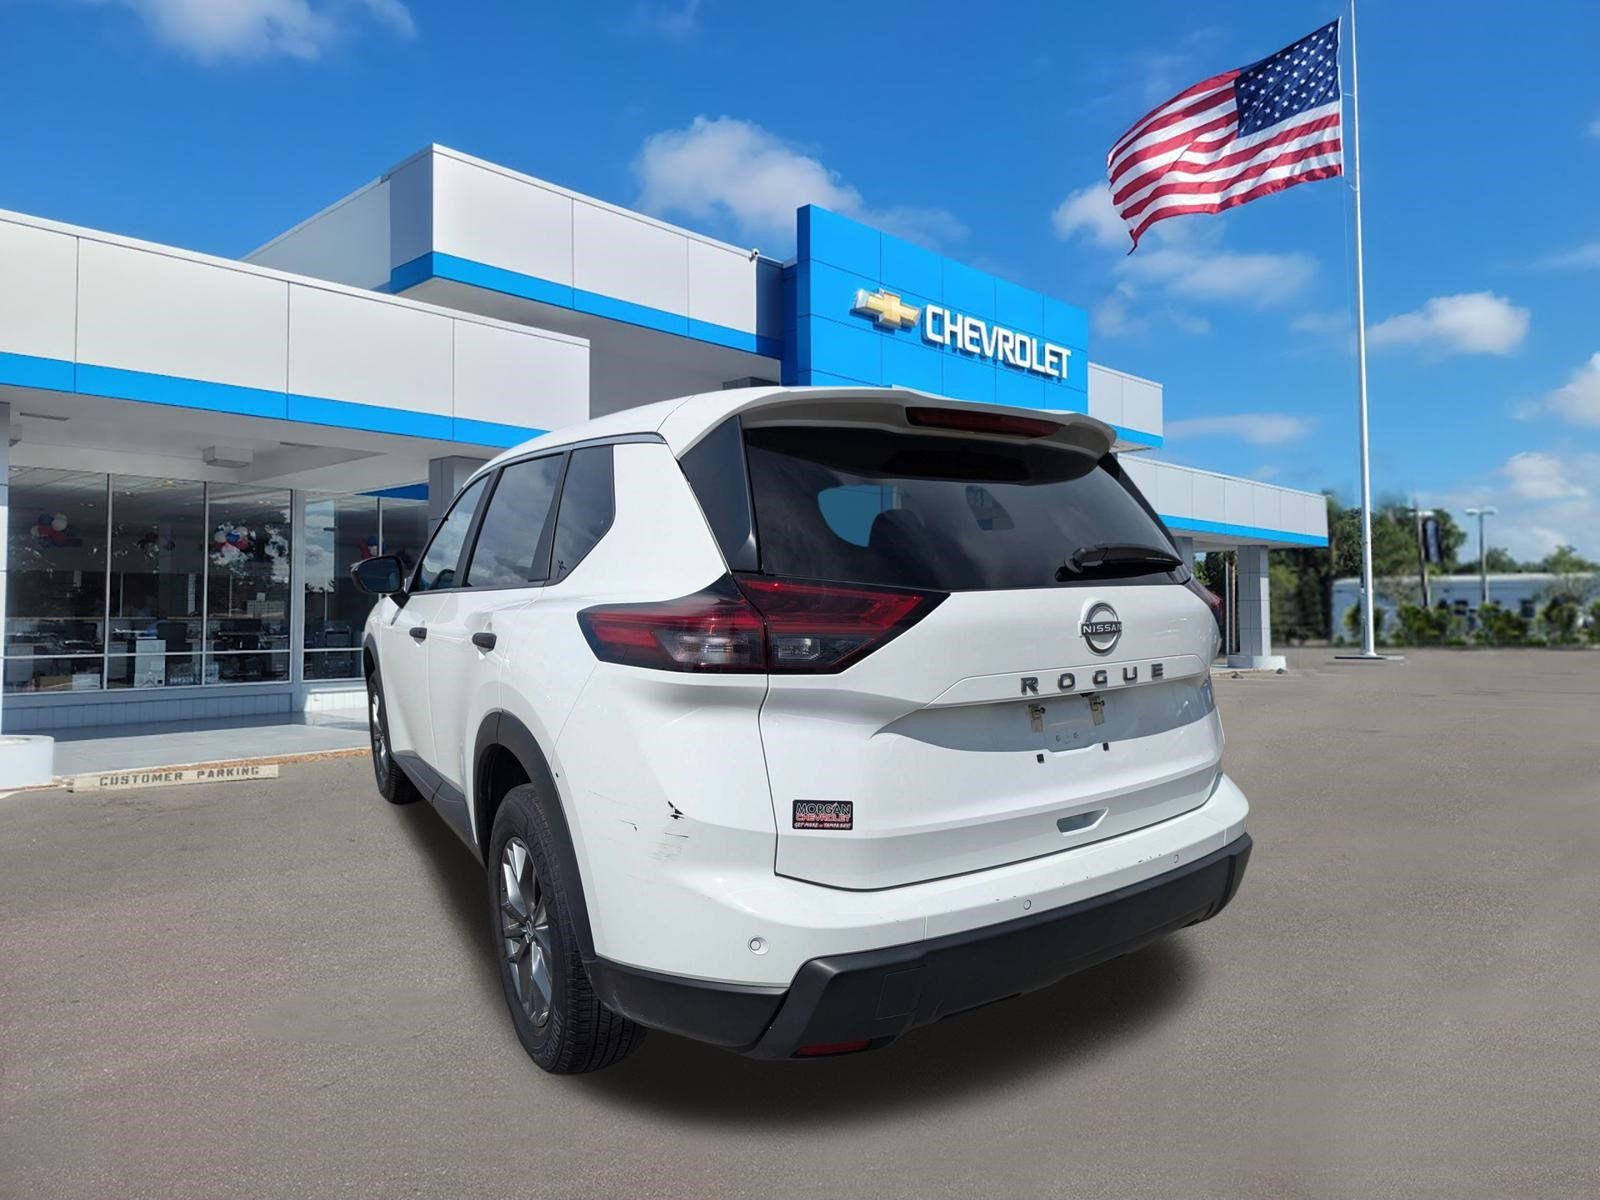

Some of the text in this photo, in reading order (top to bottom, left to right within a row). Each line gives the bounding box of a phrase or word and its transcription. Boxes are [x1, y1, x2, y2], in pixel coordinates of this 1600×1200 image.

[925, 304, 1072, 379] CHEVROLET
[1082, 624, 1122, 635] NISSAN
[1020, 663, 1164, 695] ROGUE
[99, 766, 259, 786] CUSTOMER PARKING
[796, 802, 851, 816] MORGAN
